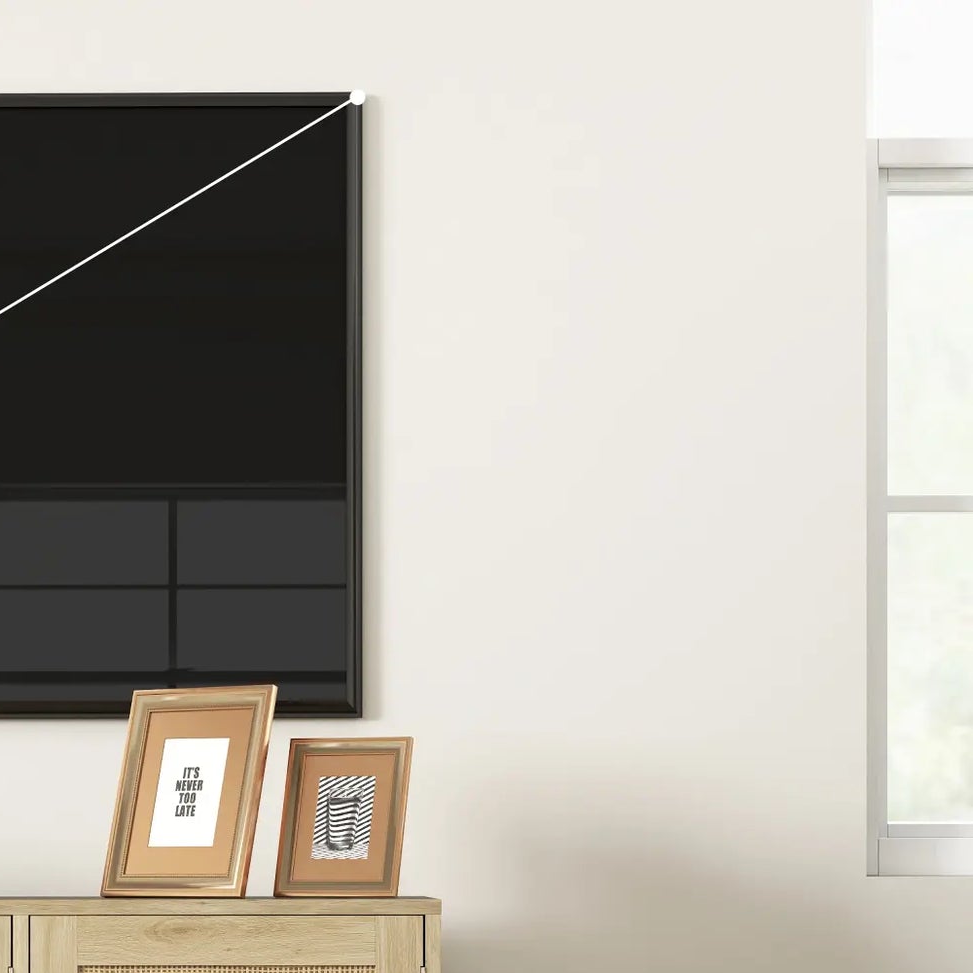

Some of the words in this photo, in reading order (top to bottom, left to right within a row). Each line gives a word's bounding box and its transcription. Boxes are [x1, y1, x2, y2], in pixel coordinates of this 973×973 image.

[182, 766, 200, 779] IT'S
[175, 780, 204, 791] NEVER
[179, 792, 197, 804] TOO
[175, 805, 197, 817] LATE
